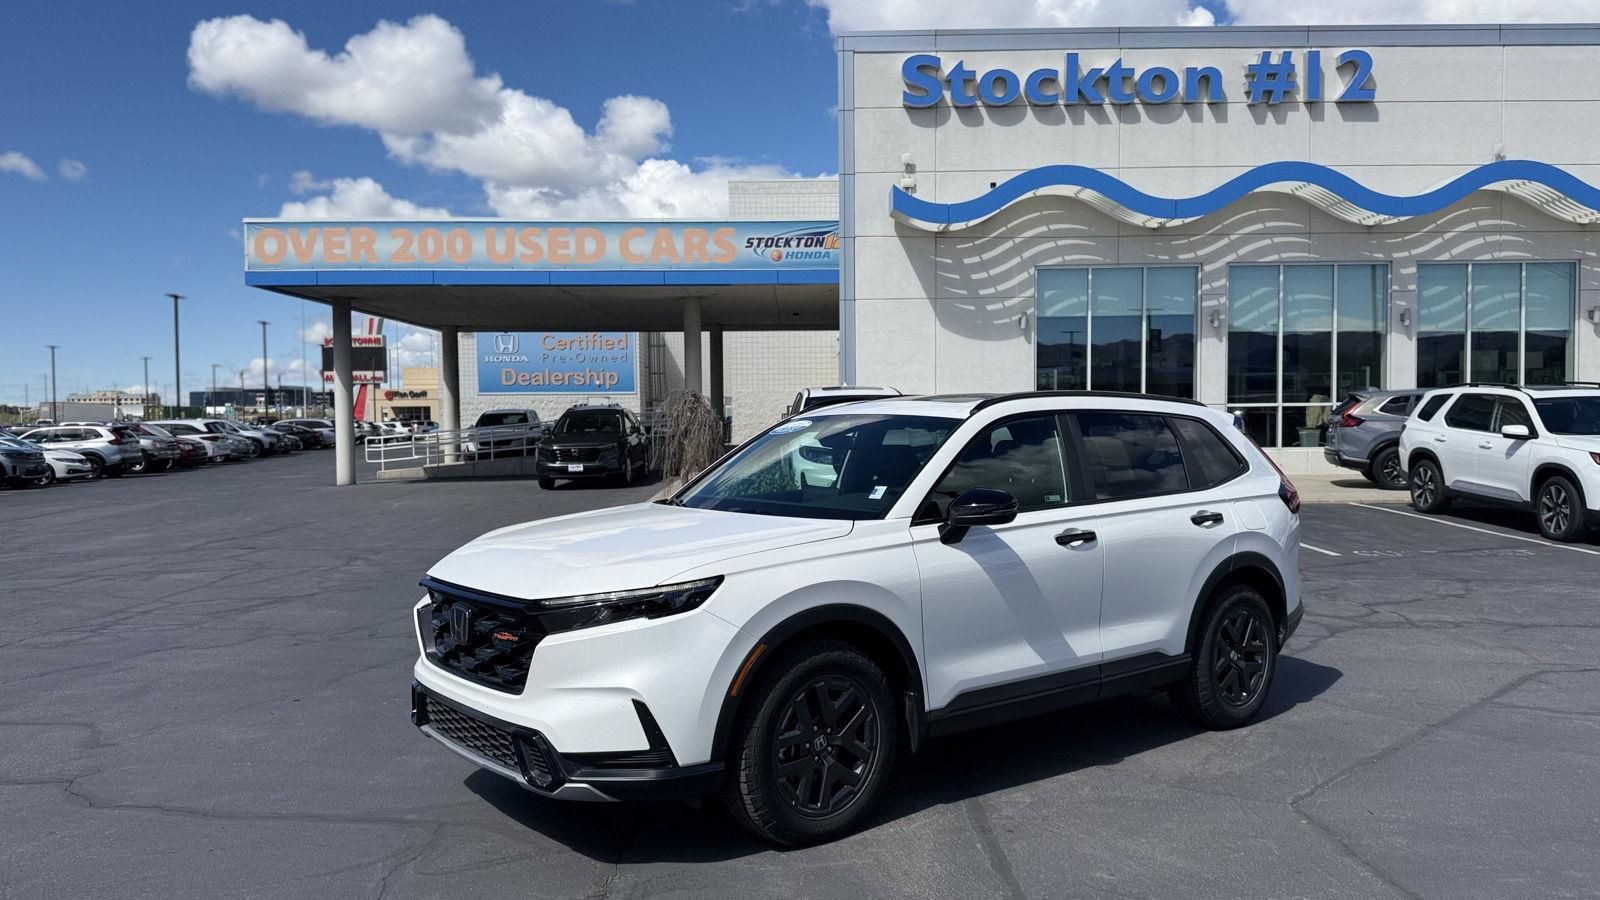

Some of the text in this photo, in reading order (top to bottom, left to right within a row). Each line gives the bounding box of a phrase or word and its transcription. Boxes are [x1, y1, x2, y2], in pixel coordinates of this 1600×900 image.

[902, 52, 1224, 109] Stockton
[254, 227, 737, 265] OVER 200 USED CARS
[745, 237, 825, 248] STOCKTON
[785, 251, 831, 259] HONDA
[541, 332, 628, 350] Certified
[542, 353, 627, 363] Pre-Owned
[501, 368, 619, 388] Dealership
